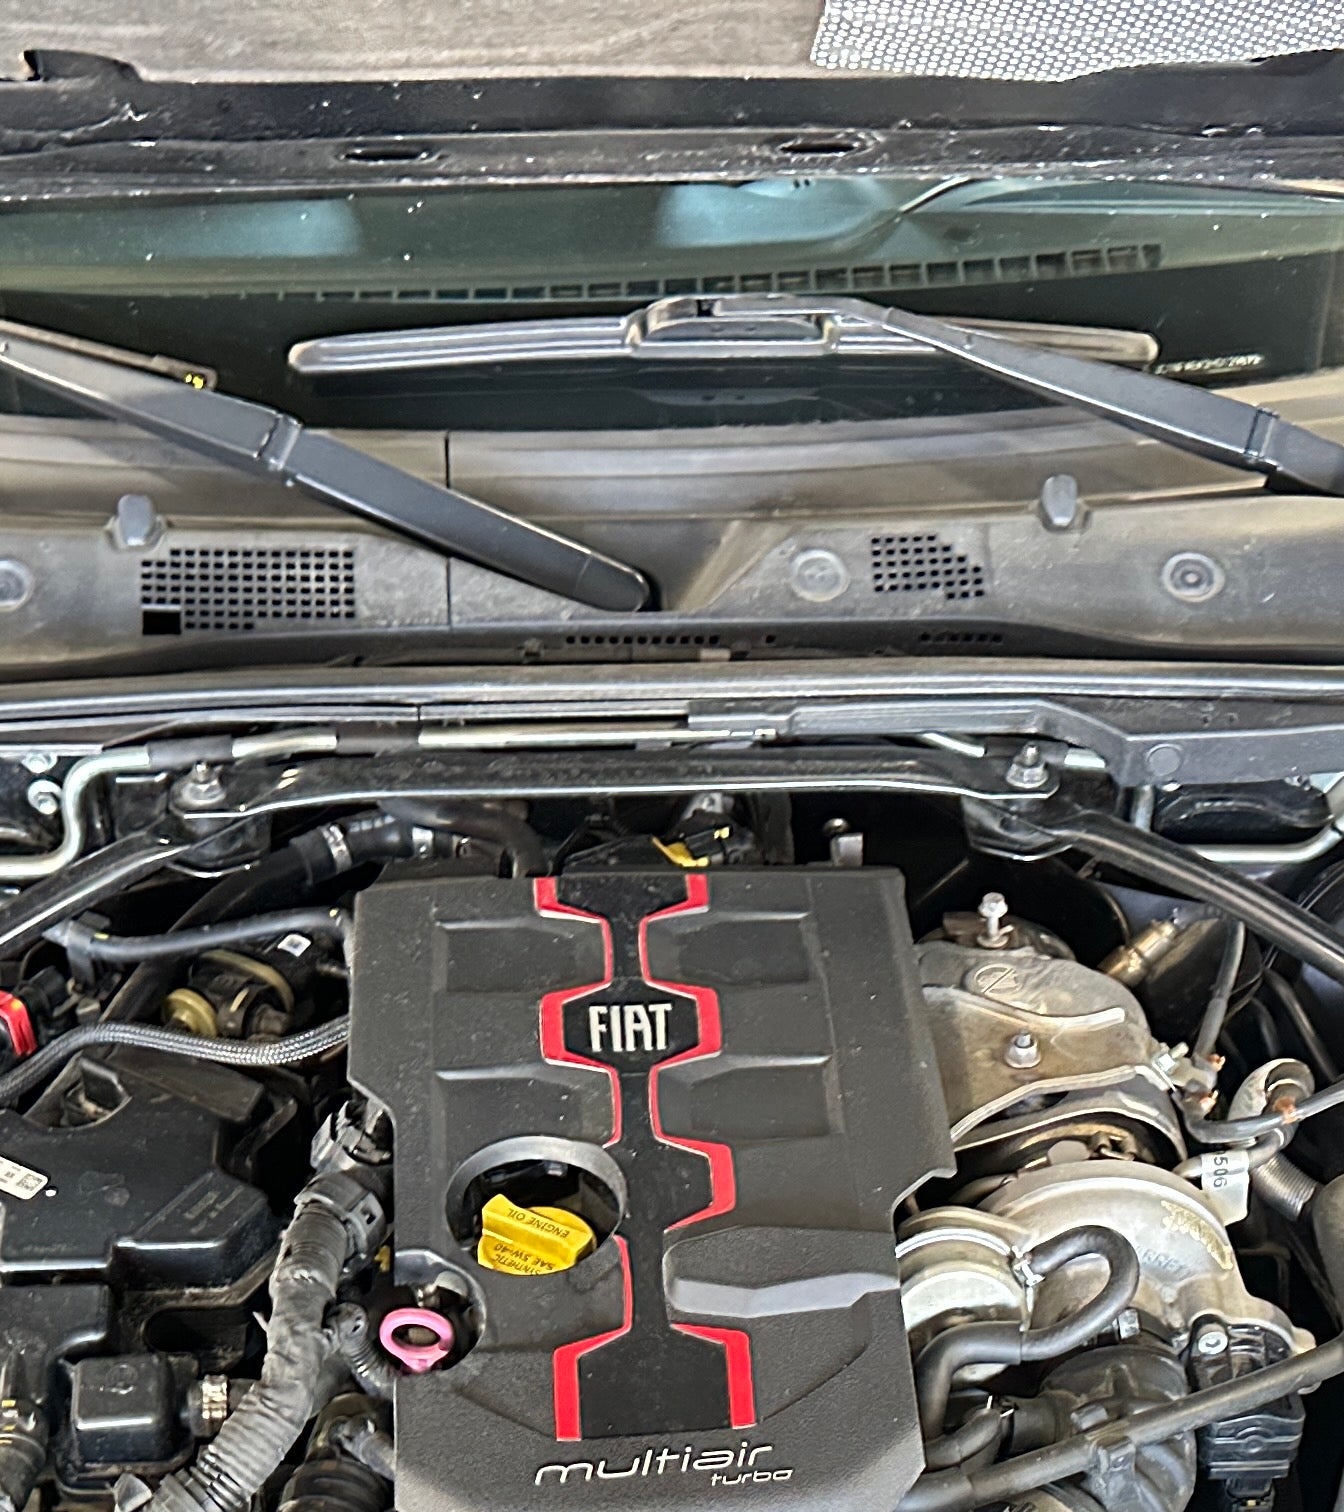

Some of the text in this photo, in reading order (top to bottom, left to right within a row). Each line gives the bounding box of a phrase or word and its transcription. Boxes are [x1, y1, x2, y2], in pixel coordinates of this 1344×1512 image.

[588, 1002, 673, 1053] FIAT
[507, 1207, 571, 1239] ENGINE OIL
[494, 1243, 557, 1271] SAE 5W-40
[534, 1441, 774, 1486] multiair
[711, 1468, 794, 1487] turbo
